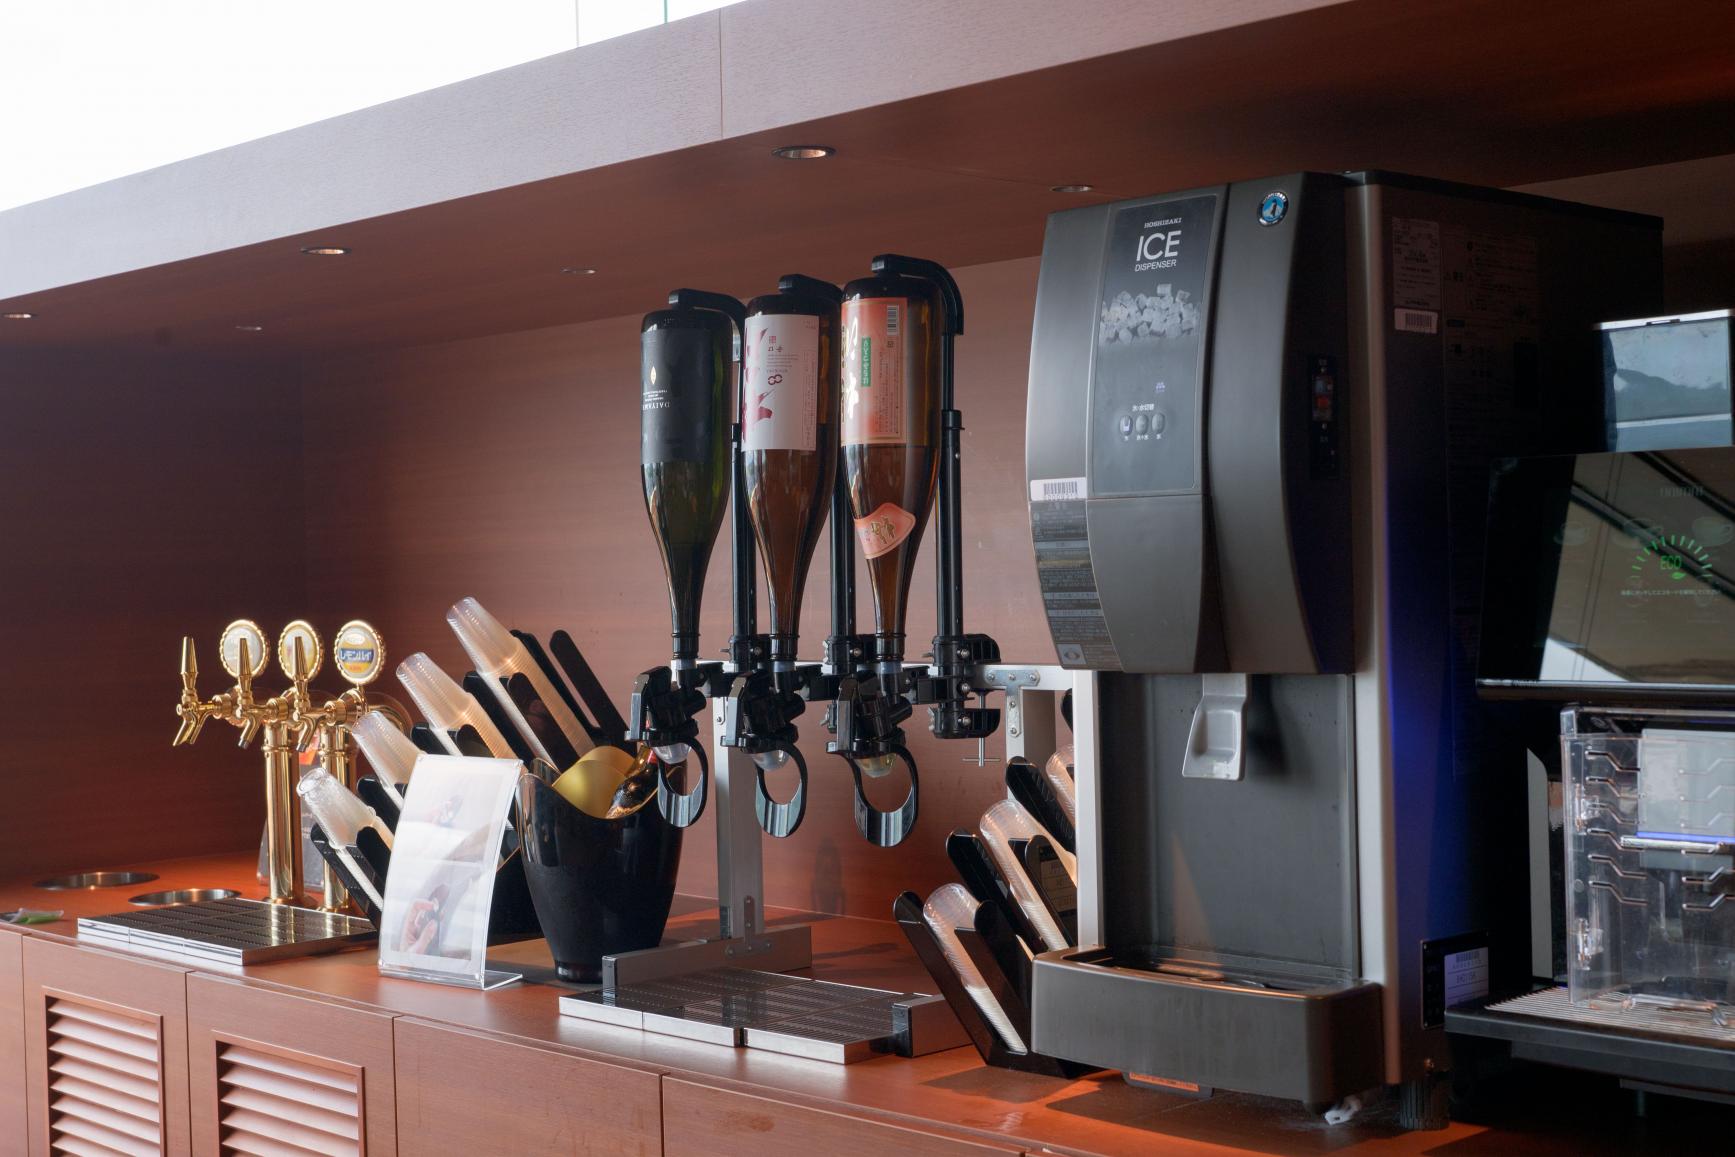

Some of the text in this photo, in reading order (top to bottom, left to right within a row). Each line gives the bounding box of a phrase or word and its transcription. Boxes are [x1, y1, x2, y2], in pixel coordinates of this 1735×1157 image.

[1136, 230, 1182, 261] ICE
[1134, 259, 1177, 272] DISPENSER
[1660, 555, 1682, 570] ECO
